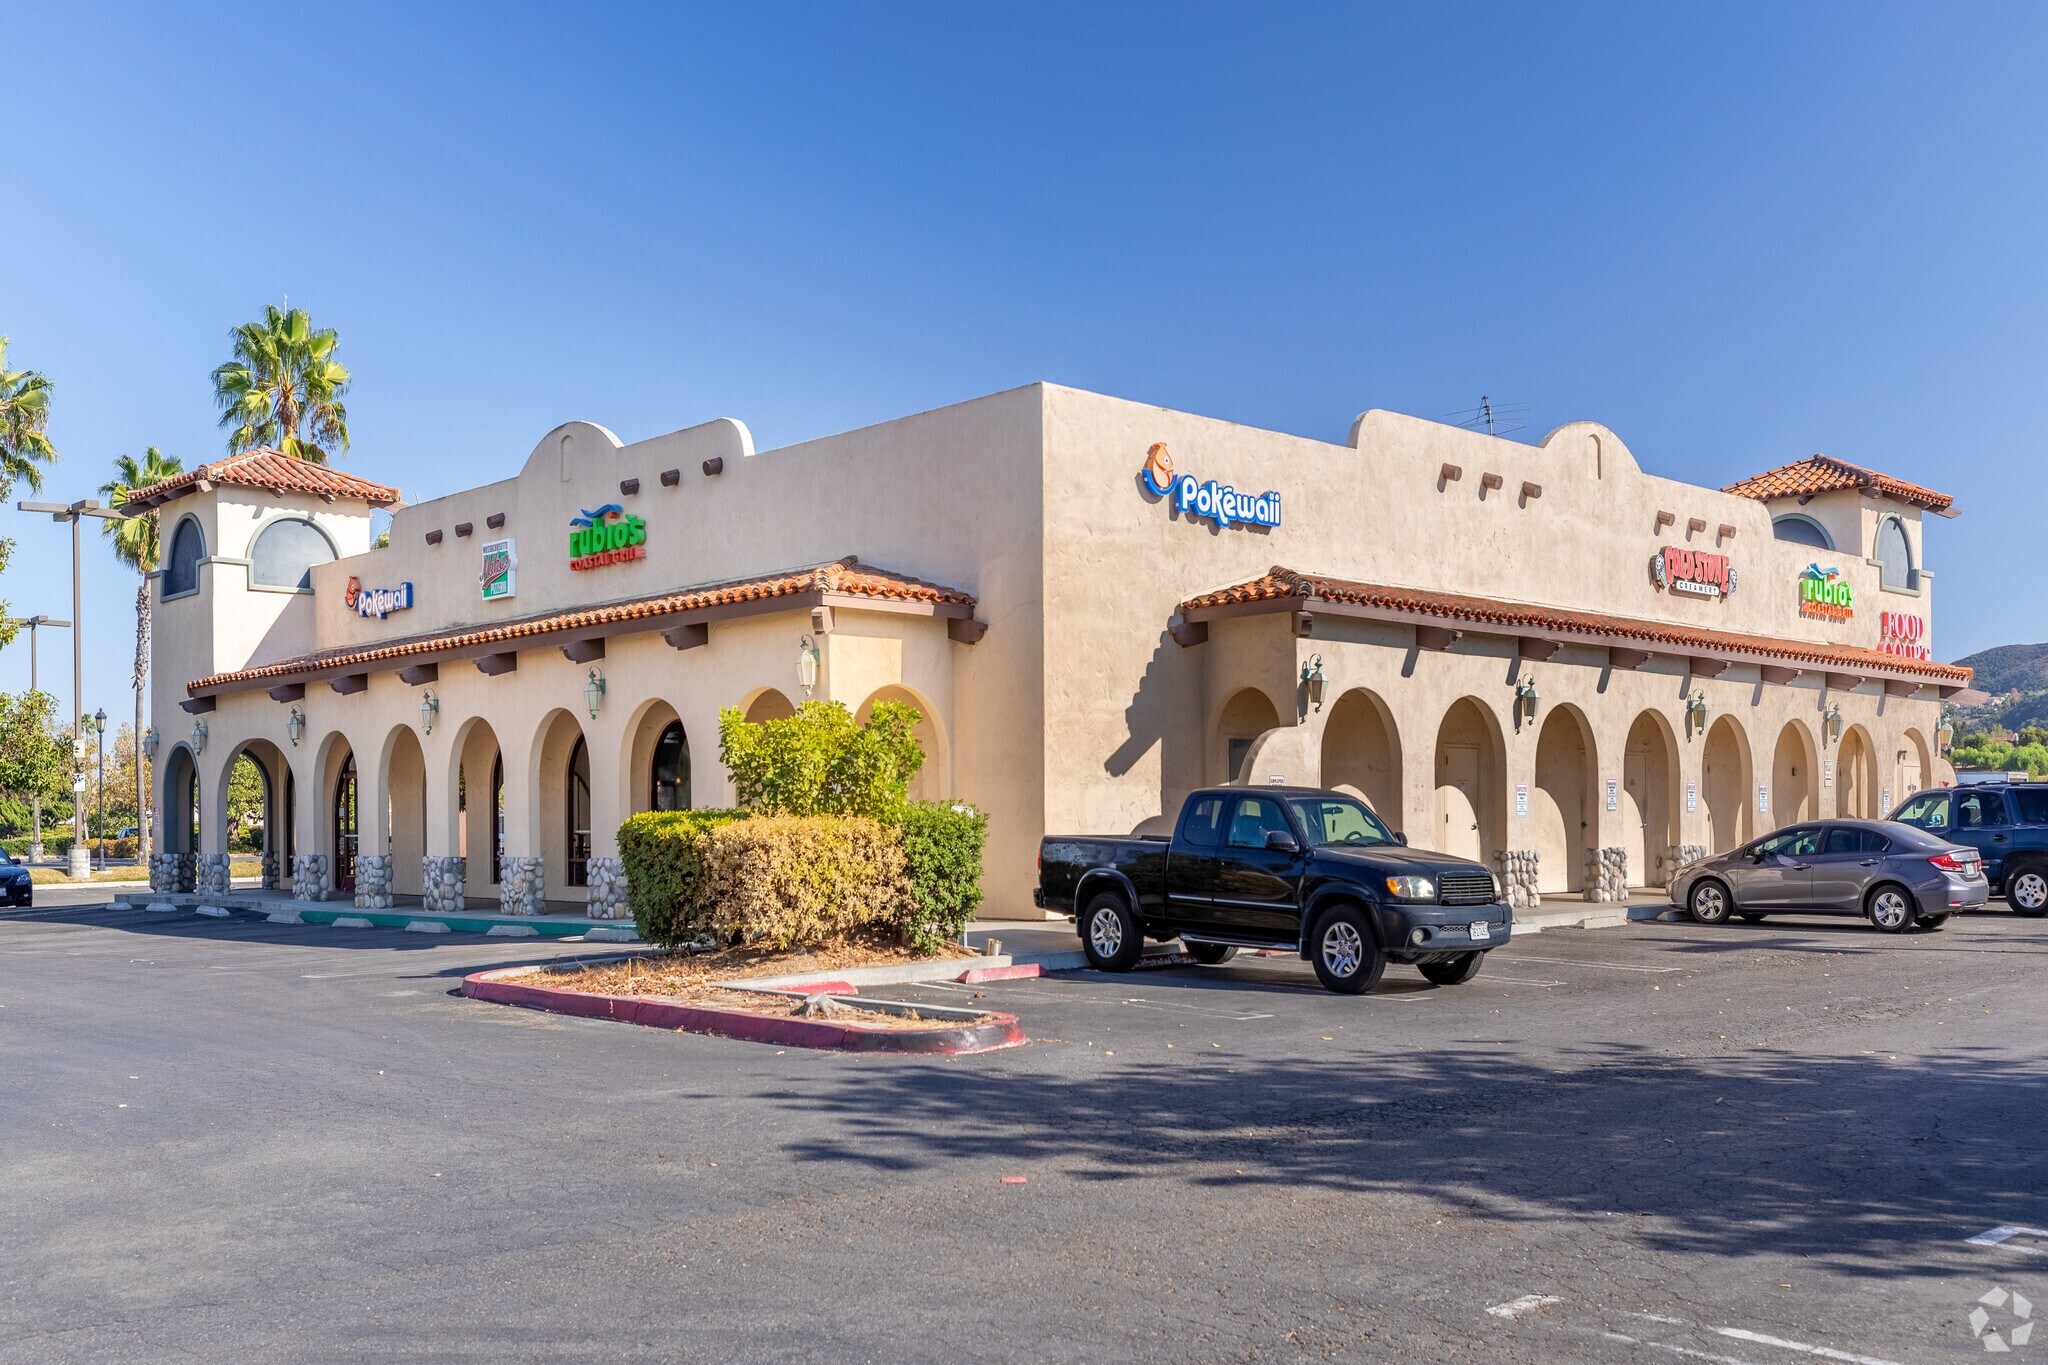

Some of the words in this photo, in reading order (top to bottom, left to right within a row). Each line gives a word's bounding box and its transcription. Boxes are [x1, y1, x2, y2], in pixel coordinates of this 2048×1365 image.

[570, 553, 614, 572] COASTAL
[1665, 546, 1695, 585] COLD
[1694, 550, 1730, 593] STONE
[1679, 581, 1718, 595] CREAMERY
[1882, 611, 1925, 641] FOOD
